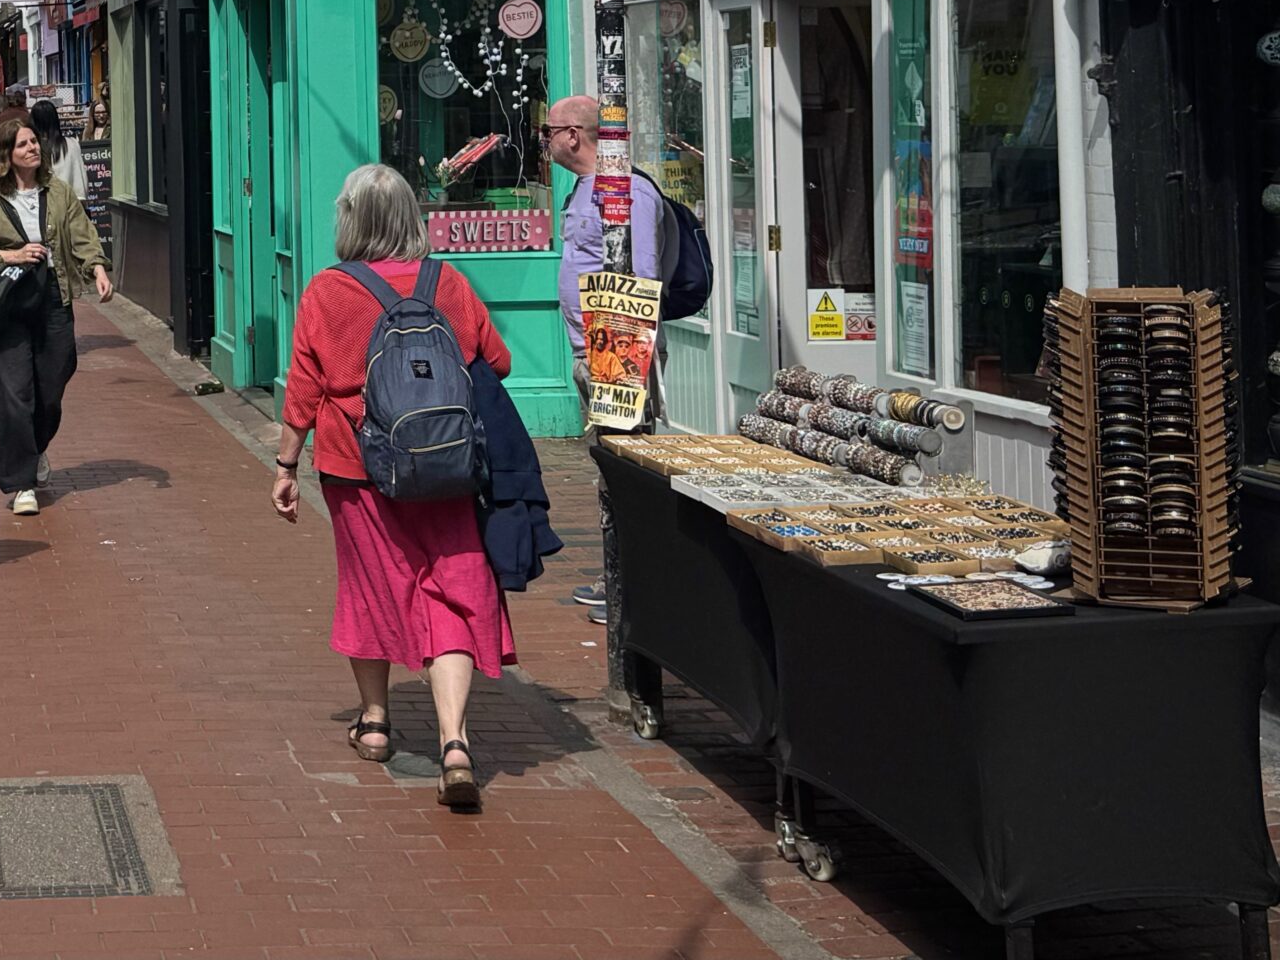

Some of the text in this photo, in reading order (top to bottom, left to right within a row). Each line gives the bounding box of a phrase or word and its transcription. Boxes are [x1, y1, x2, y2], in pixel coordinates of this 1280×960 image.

[505, 10, 535, 22] BESTIE
[982, 63, 1020, 76] YOU
[449, 220, 532, 243] SWEETS
[600, 274, 638, 296] JAZZ
[612, 388, 639, 407] MAY
[593, 401, 637, 419] BRIGHTON
